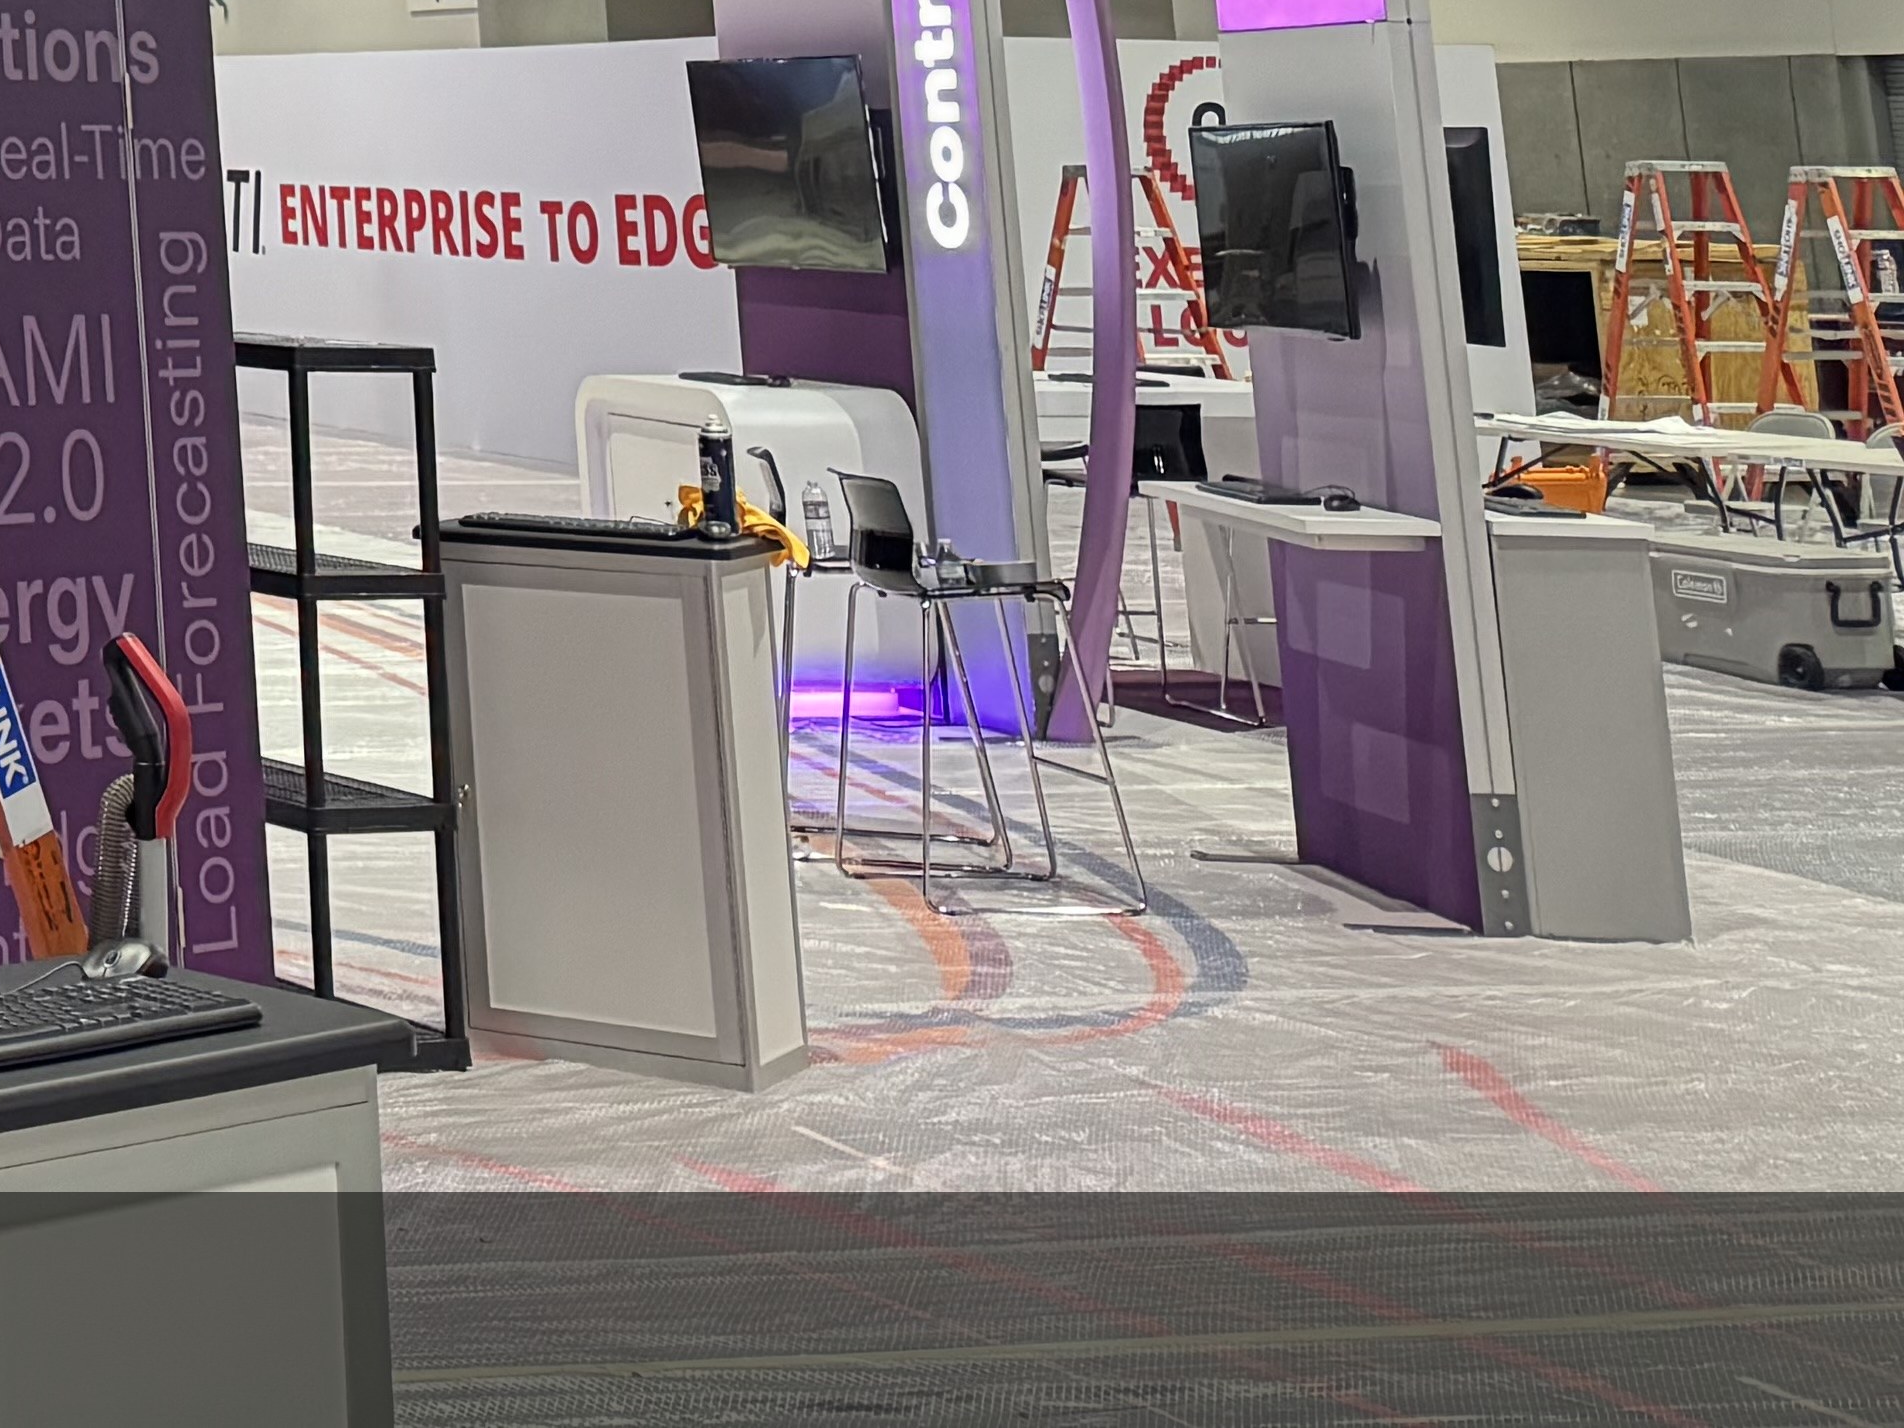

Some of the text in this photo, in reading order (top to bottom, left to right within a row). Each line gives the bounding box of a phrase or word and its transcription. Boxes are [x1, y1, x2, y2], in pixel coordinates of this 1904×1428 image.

[279, 183, 525, 261] ENTERPRISE
[539, 198, 599, 265] TO
[614, 193, 719, 270] EDG
[155, 230, 224, 715] Forecasting
[191, 750, 239, 955] Load
